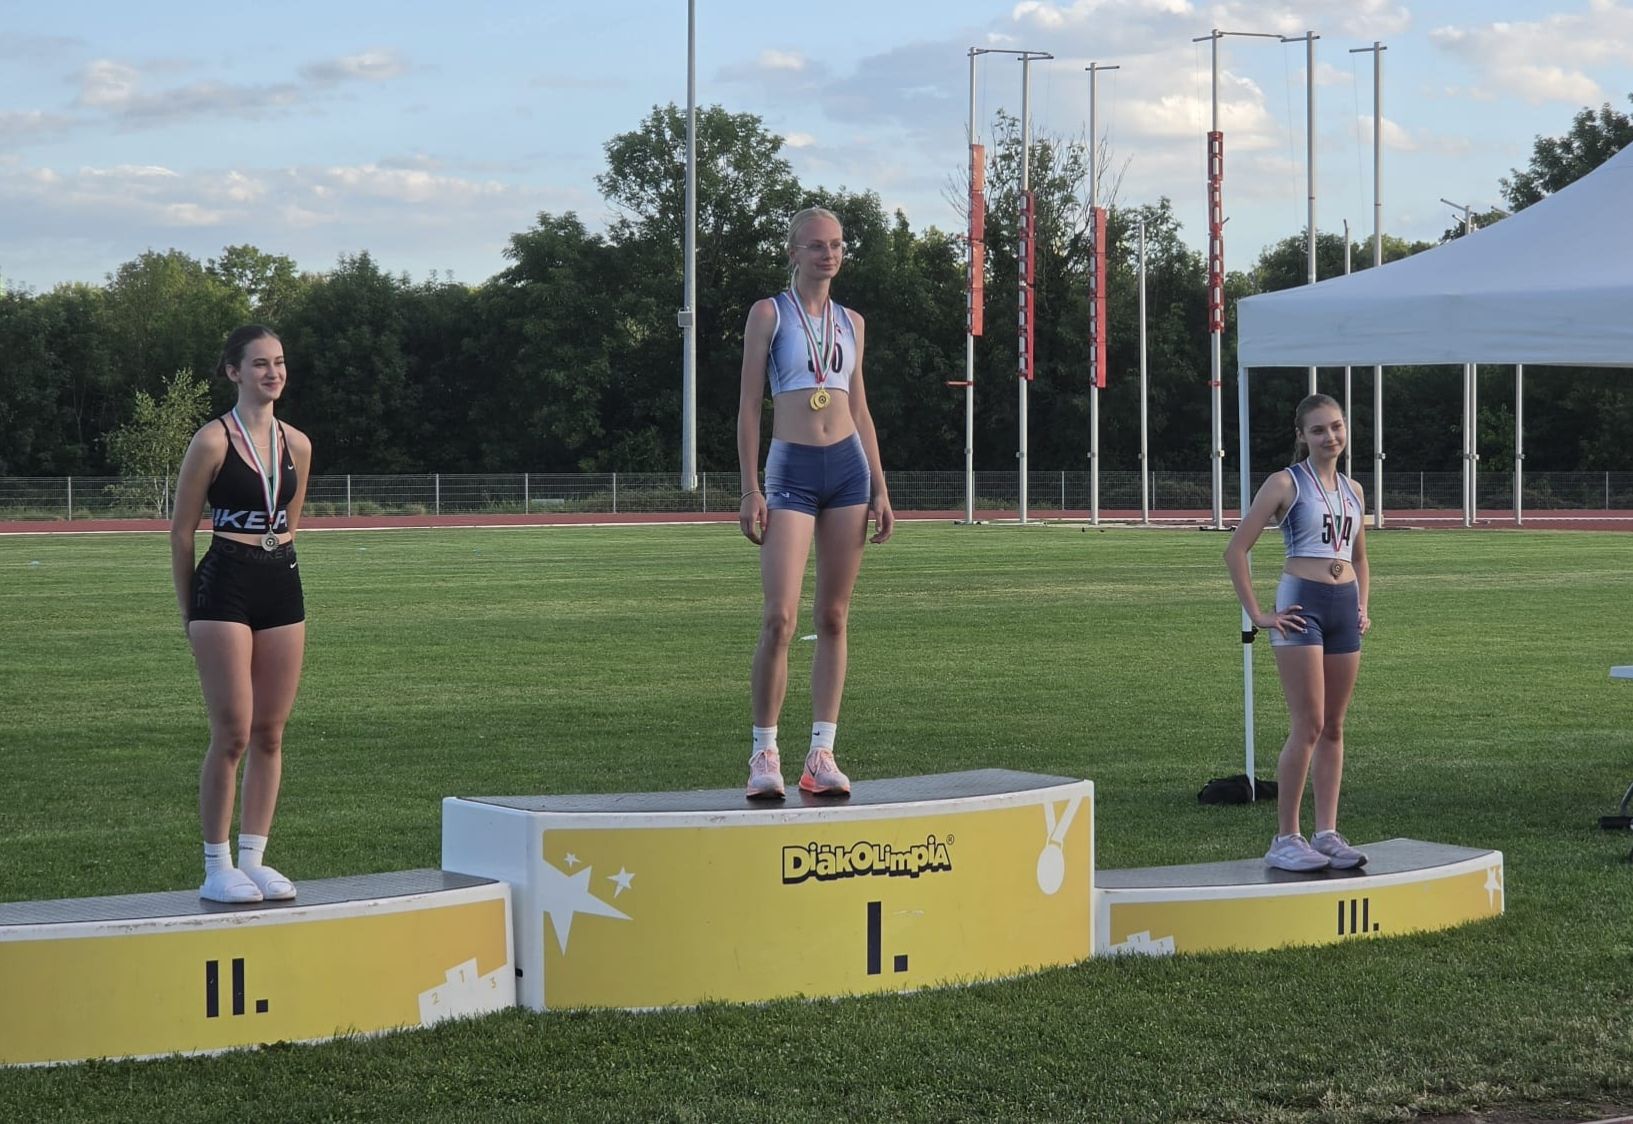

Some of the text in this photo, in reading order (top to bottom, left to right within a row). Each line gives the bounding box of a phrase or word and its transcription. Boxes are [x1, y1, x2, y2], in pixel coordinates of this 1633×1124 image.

[213, 508, 267, 530] IKE
[1321, 513, 1353, 547] 54
[1337, 898, 1380, 936] III.
[866, 901, 909, 975] I.
[206, 958, 269, 1019] II.
